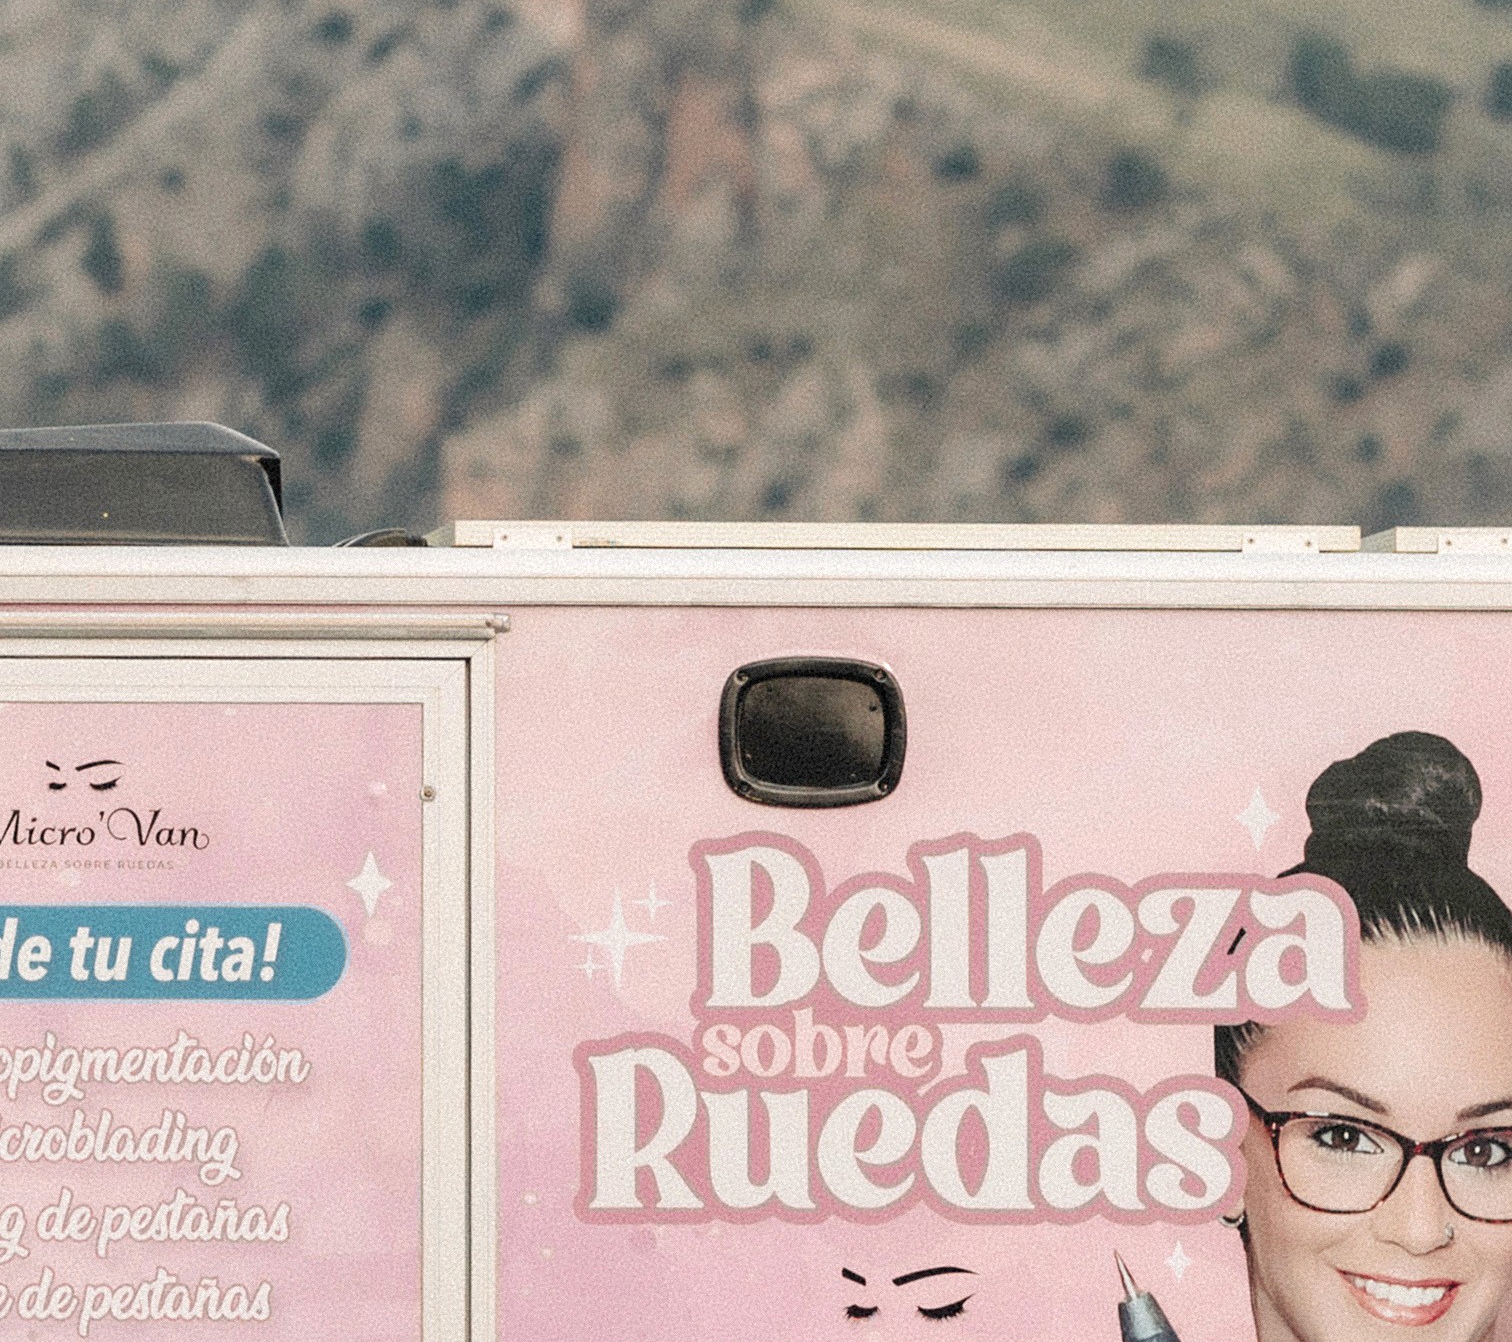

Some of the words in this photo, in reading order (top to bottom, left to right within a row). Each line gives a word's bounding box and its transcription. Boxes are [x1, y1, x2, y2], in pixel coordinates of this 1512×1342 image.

[64, 859, 110, 870] SOBRE
[117, 859, 175, 870] RUEDAS
[69, 926, 133, 982] tu
[149, 918, 283, 982] cita!
[700, 845, 1357, 1011] Belleza
[700, 1008, 937, 1079] sobre
[586, 1045, 1237, 1214] Ruedas
[36, 1185, 98, 1243] de
[95, 1186, 292, 1259] pestañas
[17, 1264, 78, 1321] de
[77, 1265, 273, 1339] pestañas
